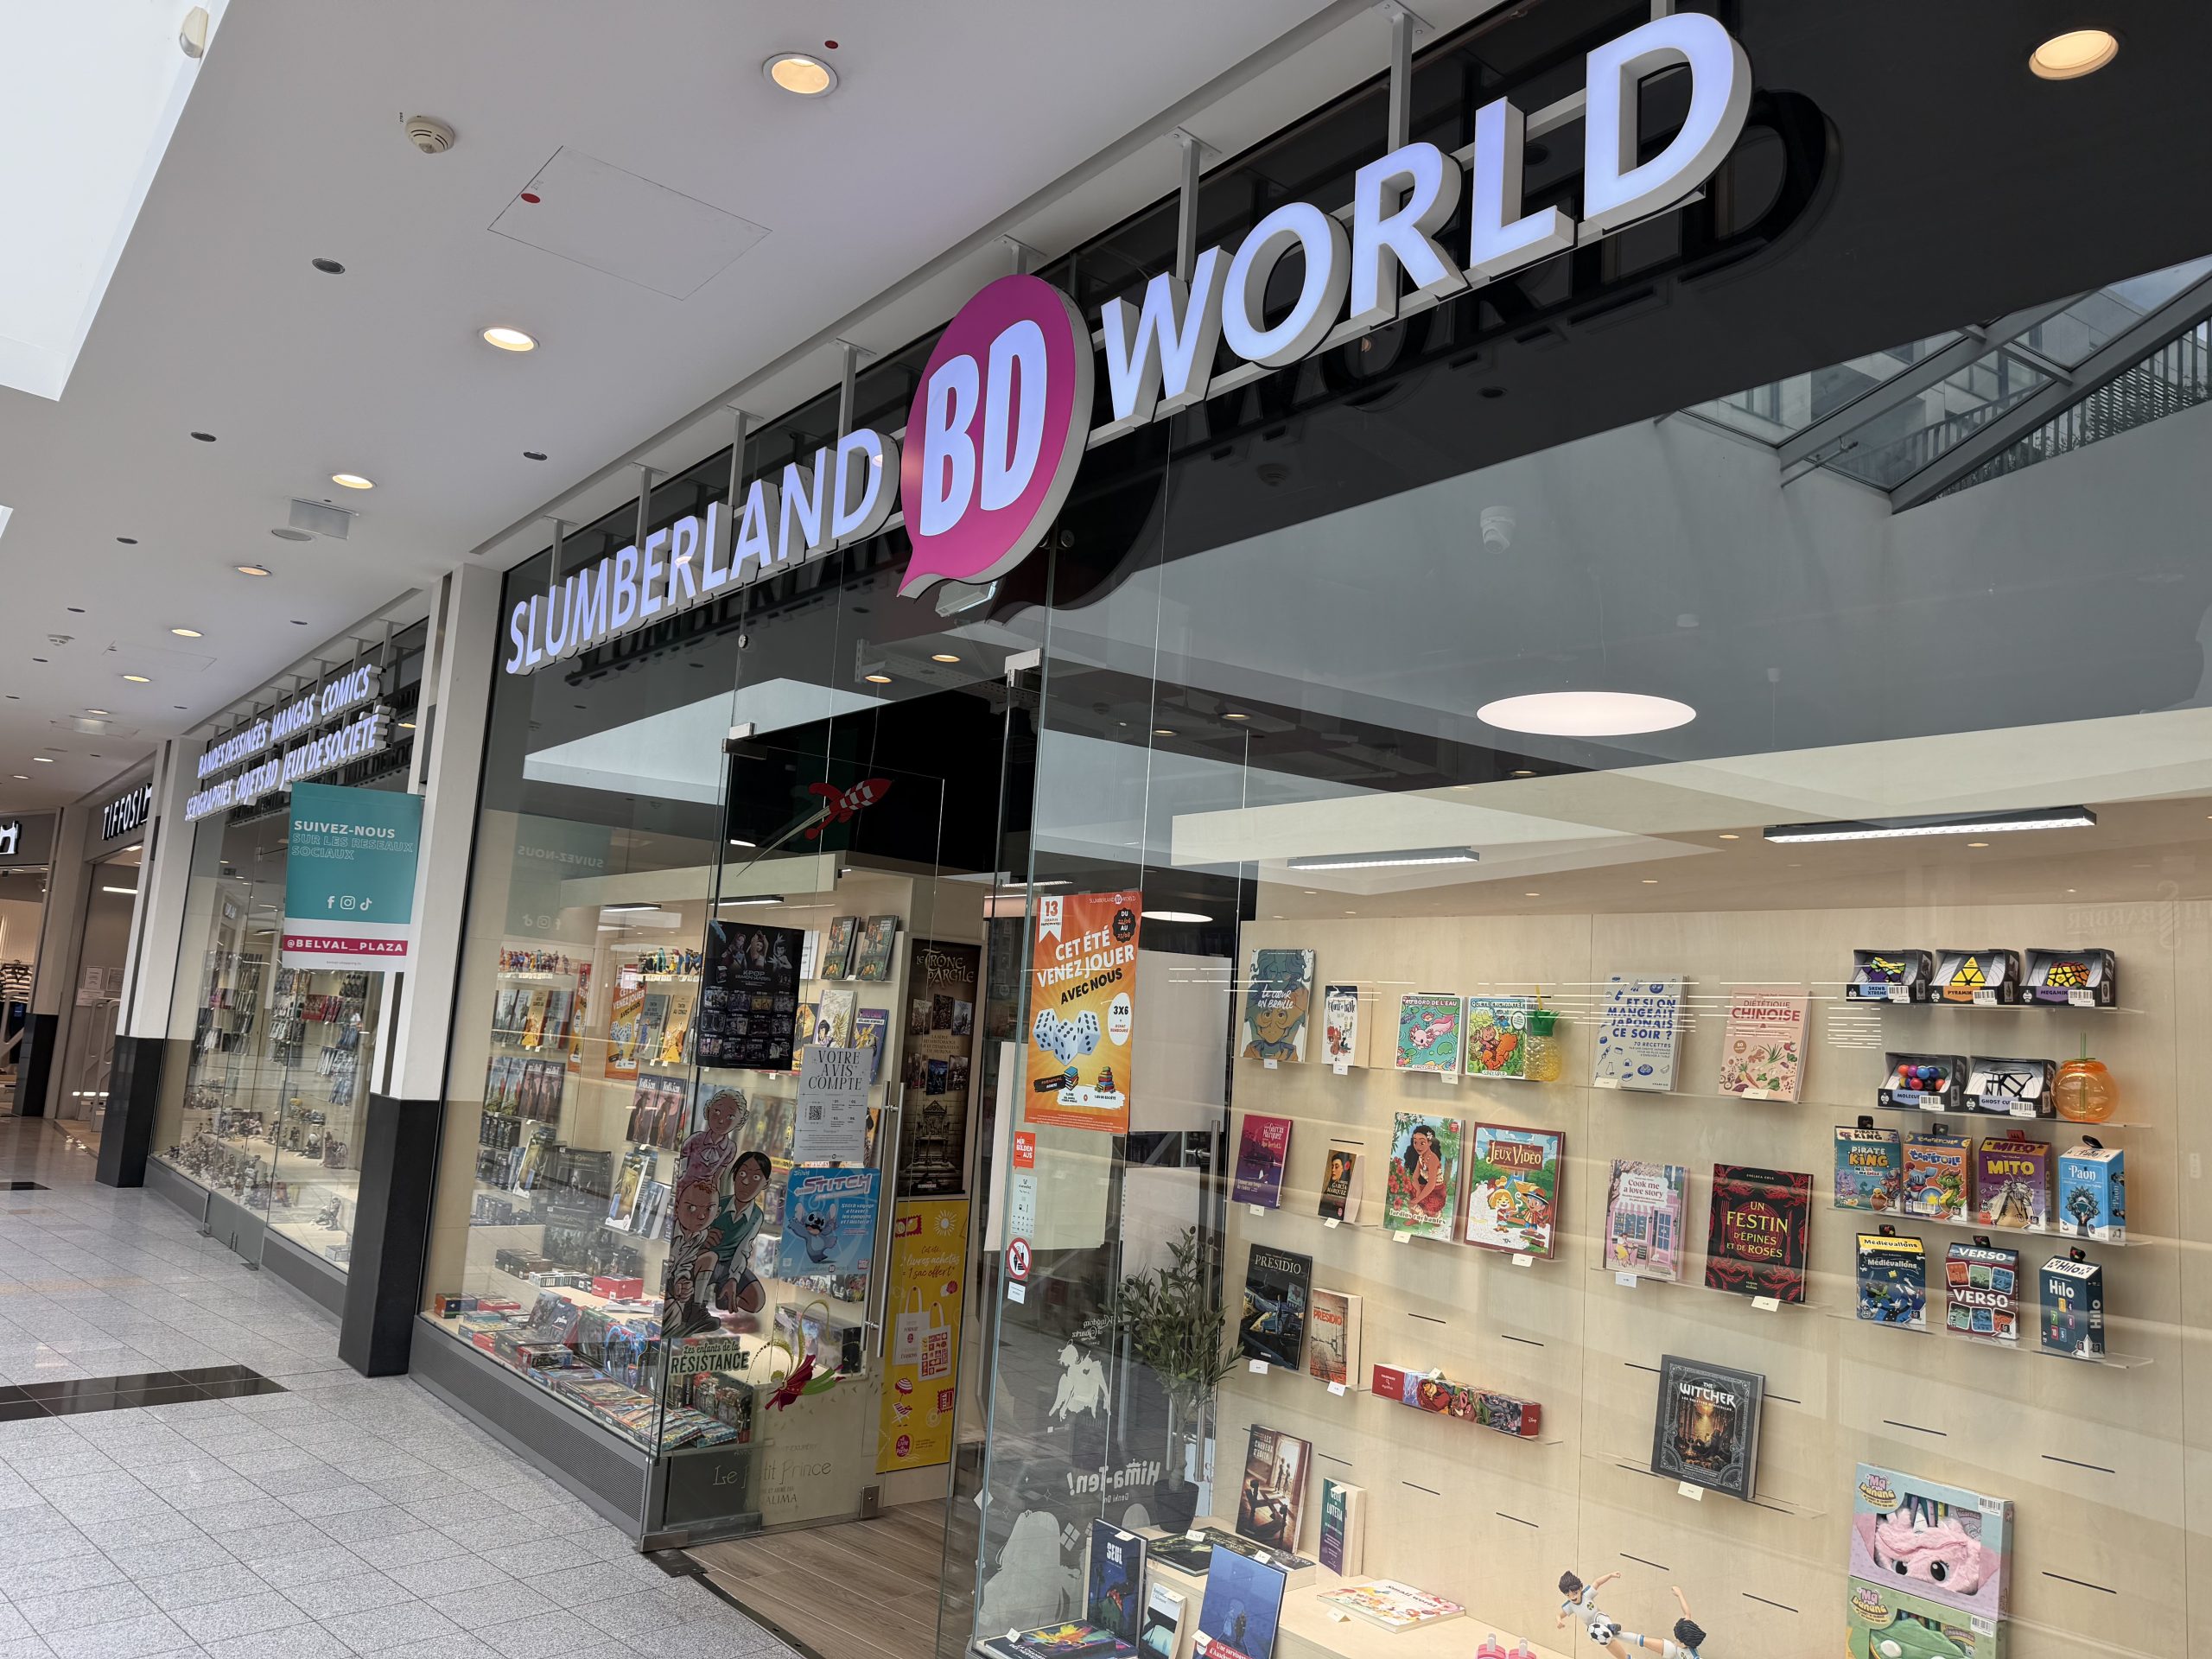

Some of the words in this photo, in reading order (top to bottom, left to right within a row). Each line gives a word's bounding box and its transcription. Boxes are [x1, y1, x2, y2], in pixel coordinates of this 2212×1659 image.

[505, 428, 888, 675] SLUMBERLAND
[920, 320, 1047, 537] BD
[1101, 11, 1743, 423] WORLD
[197, 741, 226, 779] BANDES
[225, 718, 269, 764] DESSINÉES
[270, 692, 316, 742] MANGAS
[321, 664, 372, 716] COMICS
[235, 765, 266, 804] OBJETS
[264, 758, 279, 790] BD
[279, 743, 310, 791] JEUX
[307, 737, 325, 771] DE
[323, 704, 381, 765] SOCIÉTÉ
[101, 786, 143, 840] TIFFOSI
[294, 820, 396, 839] SUIVEZ-NOUS
[292, 833, 320, 845] SUR
[323, 835, 348, 848] LES
[291, 845, 354, 861] SOCIAUX
[1045, 900, 1058, 916] 13
[1055, 938, 1081, 961] CET
[1083, 925, 1110, 953] ÉTÉ
[916, 956, 925, 965] LE
[922, 949, 964, 970] TRÔNE
[1037, 958, 1083, 988] VENEZ
[1084, 944, 1135, 979] JOUER
[1061, 982, 1090, 1005] AVEC
[1090, 968, 1123, 991] NOUS
[613, 995, 631, 1010] VENEZ
[1626, 998, 1640, 1007] ET
[1643, 999, 1653, 1007] SI
[1656, 999, 1676, 1008] ON
[1607, 1007, 1675, 1019] MANGEAIT
[1732, 1007, 1801, 1021] CHINOISE
[1611, 1017, 1674, 1029] JAPONAIS
[1612, 1027, 1627, 1038] CE
[1630, 1028, 1661, 1039] SOIR
[1665, 1030, 1672, 1040] ?
[818, 1050, 861, 1065] VOTRE
[821, 1064, 853, 1077] AVIS
[639, 1077, 655, 1089] Tolkien
[663, 1080, 680, 1092] Tolkien
[808, 1076, 862, 1090] COMPTE
[1486, 1141, 1511, 1164] JEUX
[1512, 1144, 1541, 1166] VIDÉO
[1851, 1146, 1886, 1155] PIRATE
[1992, 1141, 2036, 1154] MITO
[1848, 1154, 1889, 1167] KING
[1987, 1160, 2035, 1176] MITO
[2069, 1165, 2096, 1181] Paon
[794, 1173, 873, 1196] STITCH
[1628, 1179, 1646, 1188] Cook
[1644, 1188, 1664, 1198] story
[1750, 1201, 1764, 1211] UN
[1389, 1208, 1412, 1219] Jardins
[1413, 1213, 1446, 1225] enchantés
[1726, 1211, 1789, 1236] FESTIN
[1733, 1230, 1777, 1245] D'ÉPINES
[1958, 1247, 2007, 1262] VERSO
[1255, 1254, 1301, 1274] PRESIDIO
[2056, 1262, 2081, 1274] Hilo
[2049, 1279, 2075, 1299] Hilo
[1953, 1288, 2009, 1308] VERSO
[1313, 1308, 1343, 1326] PRESIDIO
[2090, 1299, 2101, 1329] Hilo
[683, 1345, 695, 1354] Les
[696, 1343, 721, 1353] enfants
[722, 1344, 730, 1353] de
[731, 1340, 740, 1351] la
[671, 1351, 750, 1374] RÉSISTANCE
[1679, 1382, 1737, 1408] WITCHER
[712, 1465, 738, 1486] Le
[779, 1460, 832, 1485] Prince
[1868, 1474, 1888, 1491] Ma
[1106, 1541, 1123, 1565] SEUL
[1860, 1588, 1879, 1605] Ma
[1216, 1641, 1226, 1651] Une
